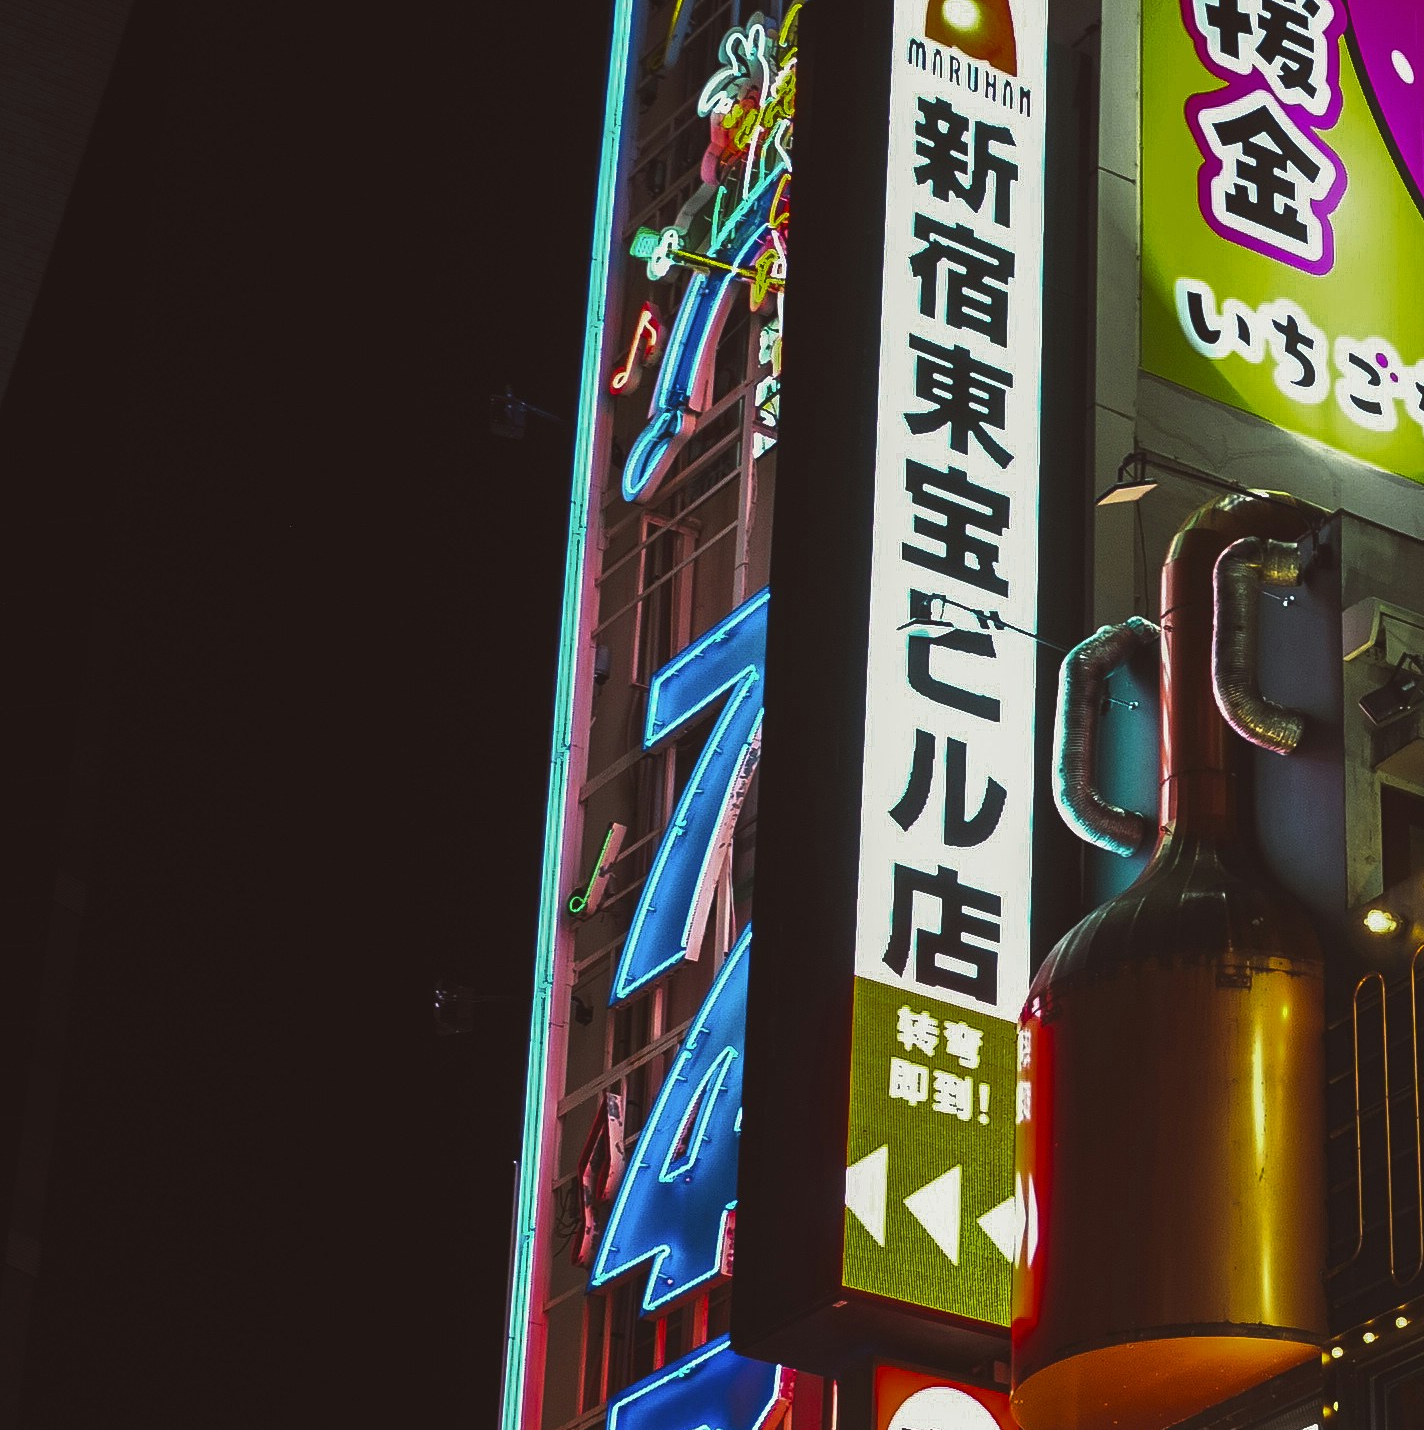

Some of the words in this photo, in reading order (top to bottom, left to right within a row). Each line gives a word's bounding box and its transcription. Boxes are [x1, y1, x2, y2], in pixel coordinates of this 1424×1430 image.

[908, 37, 1033, 119] MARUHAN
[882, 93, 1020, 1004] 新宿東宝ビル店
